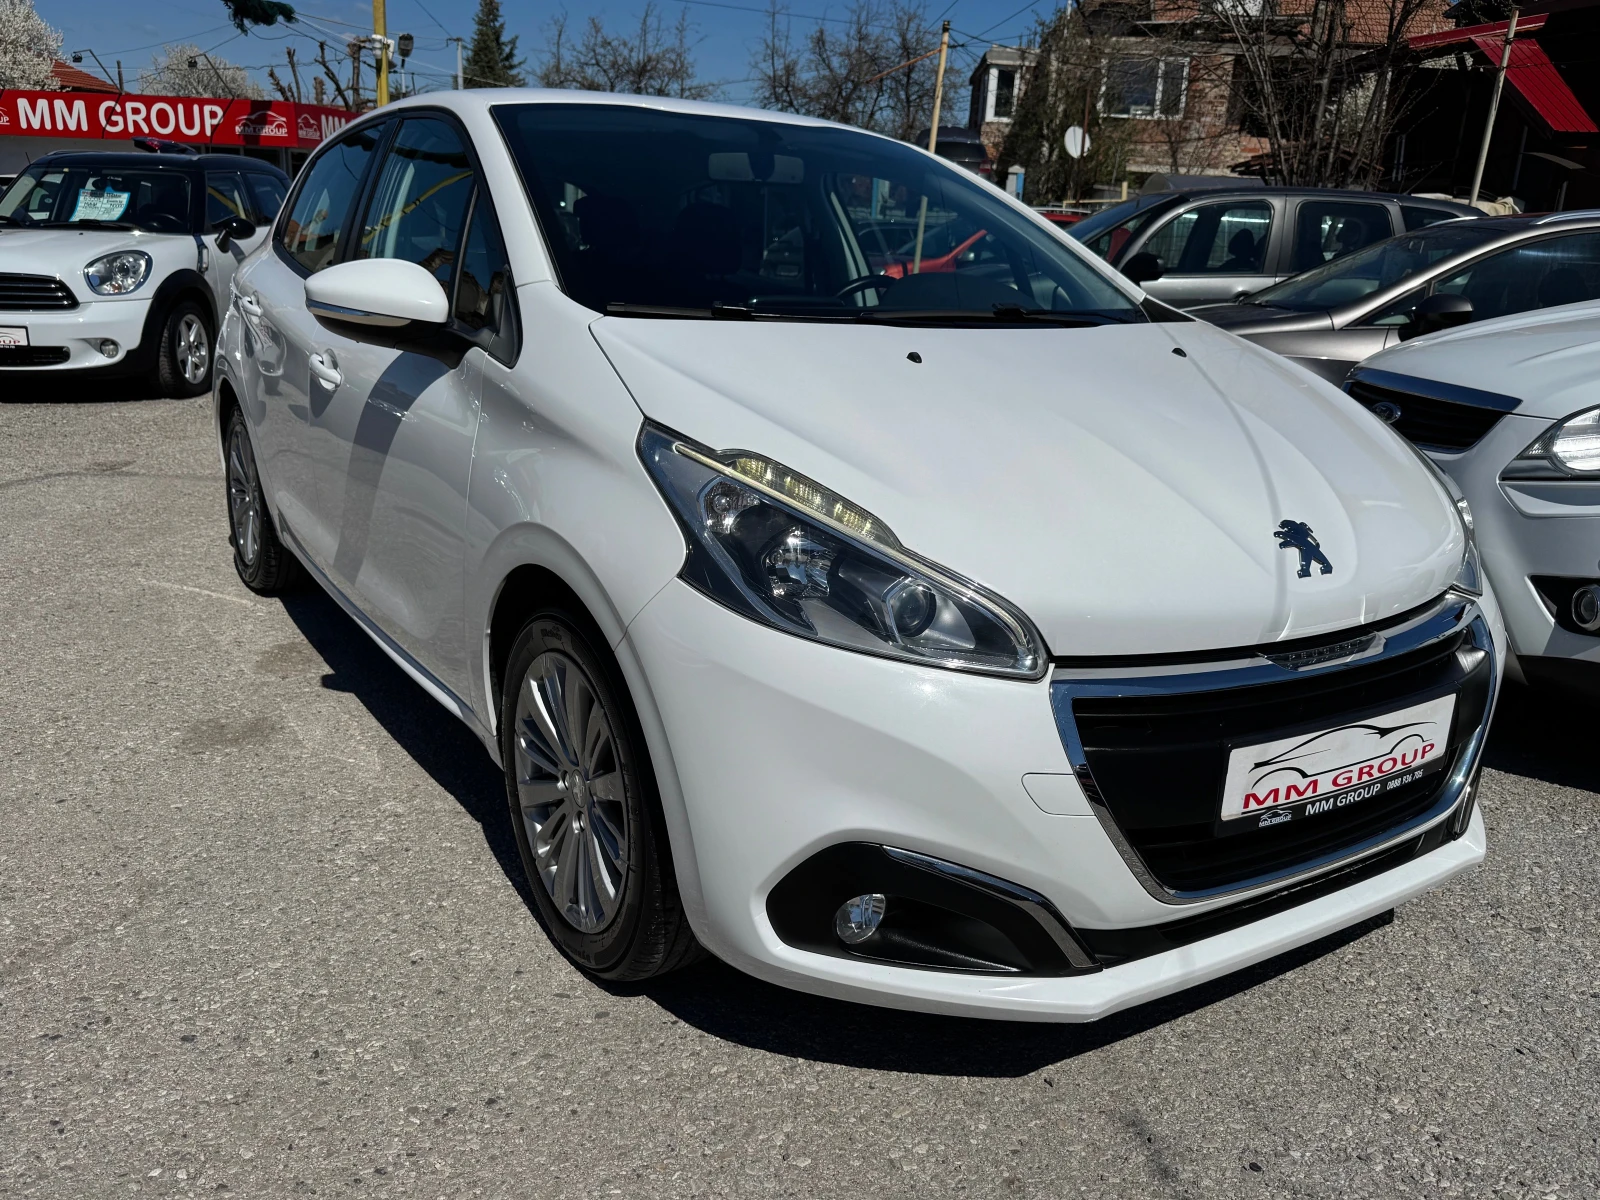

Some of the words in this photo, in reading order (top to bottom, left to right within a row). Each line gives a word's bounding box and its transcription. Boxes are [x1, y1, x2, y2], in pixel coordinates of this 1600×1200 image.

[17, 98, 88, 132] MM
[98, 101, 223, 137] GROUP
[235, 125, 256, 134] MM
[256, 125, 288, 135] GROUP
[1243, 779, 1319, 809] MM
[1331, 743, 1435, 788] GROUP
[1305, 798, 1333, 816] MM
[1336, 784, 1381, 806] GROUP
